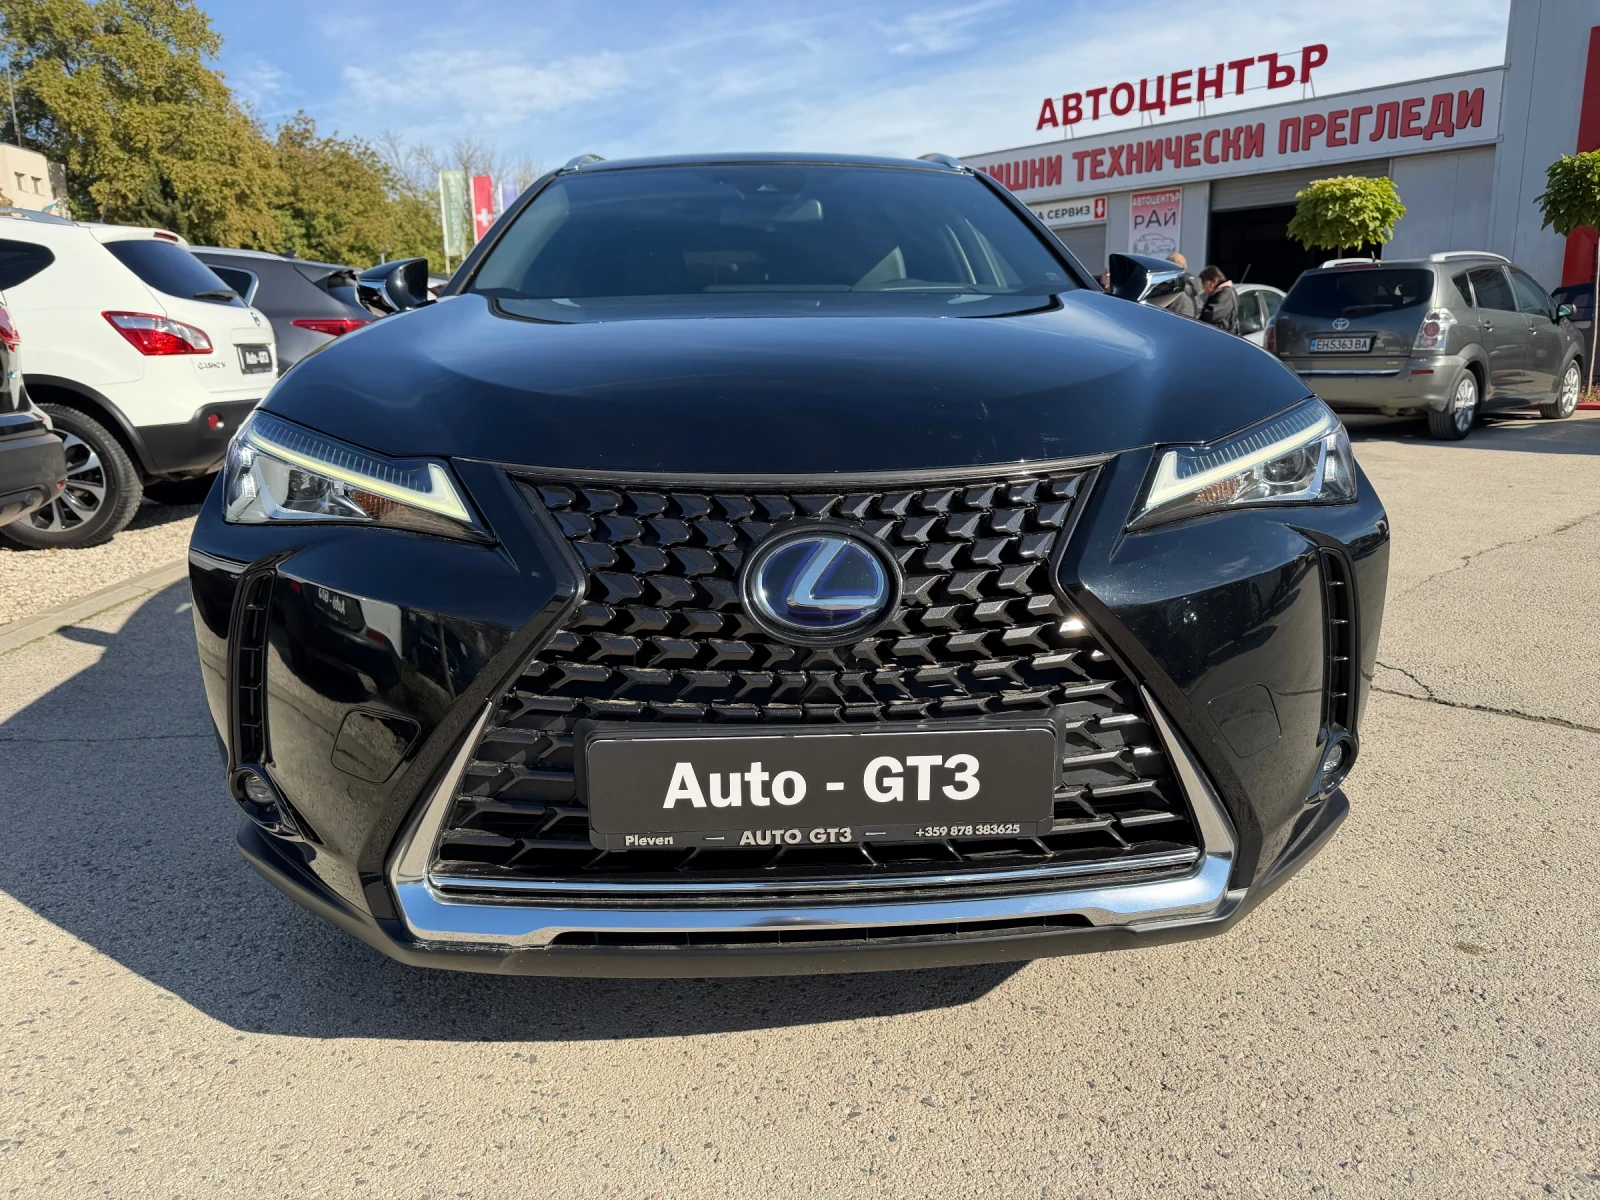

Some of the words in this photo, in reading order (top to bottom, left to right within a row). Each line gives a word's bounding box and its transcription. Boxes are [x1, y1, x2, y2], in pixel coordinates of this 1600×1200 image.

[1037, 44, 1328, 131] АВТОЦЕНТЪР
[978, 155, 1062, 192] ИШНИ
[1072, 122, 1265, 182] ТЕХНИЧЕСКИ
[1278, 87, 1485, 154] ПРЕГЛЕДИ
[1047, 205, 1091, 220] СЕРВИЗ
[1132, 191, 1181, 207] АВТОЦЕНТЪР
[662, 761, 807, 809] Auto
[864, 753, 981, 803] GT3
[625, 833, 674, 847] Pleven
[739, 828, 802, 846] AUTO
[809, 827, 852, 844] GT3
[915, 825, 945, 838] +359
[947, 824, 973, 837] 878
[975, 822, 1021, 836] 383625
